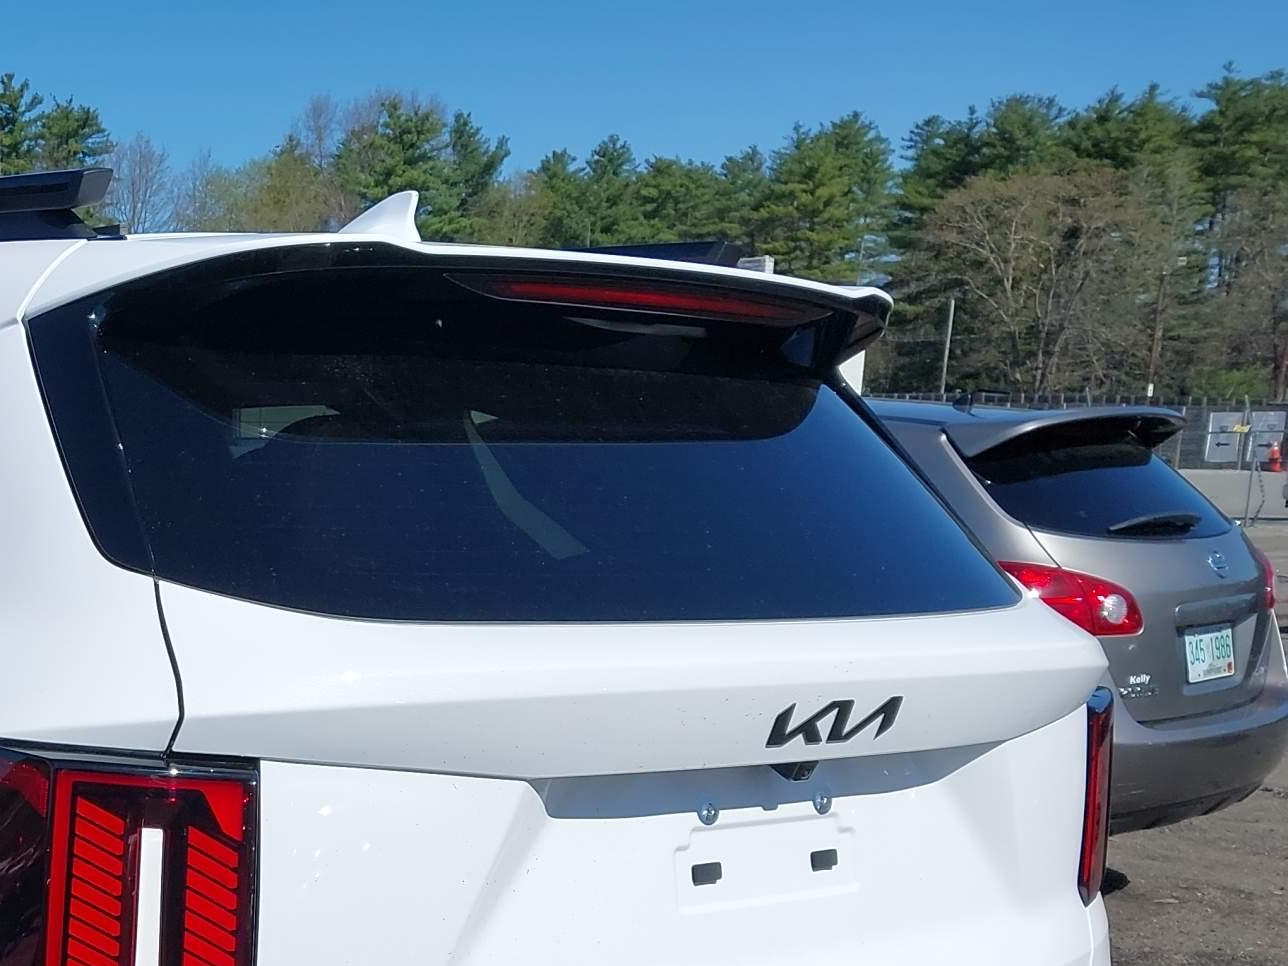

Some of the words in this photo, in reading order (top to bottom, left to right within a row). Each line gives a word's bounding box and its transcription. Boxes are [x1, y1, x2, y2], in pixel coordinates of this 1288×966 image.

[1189, 638, 1206, 665] 345
[1210, 634, 1232, 661] 1986
[1129, 673, 1151, 685] Kelly
